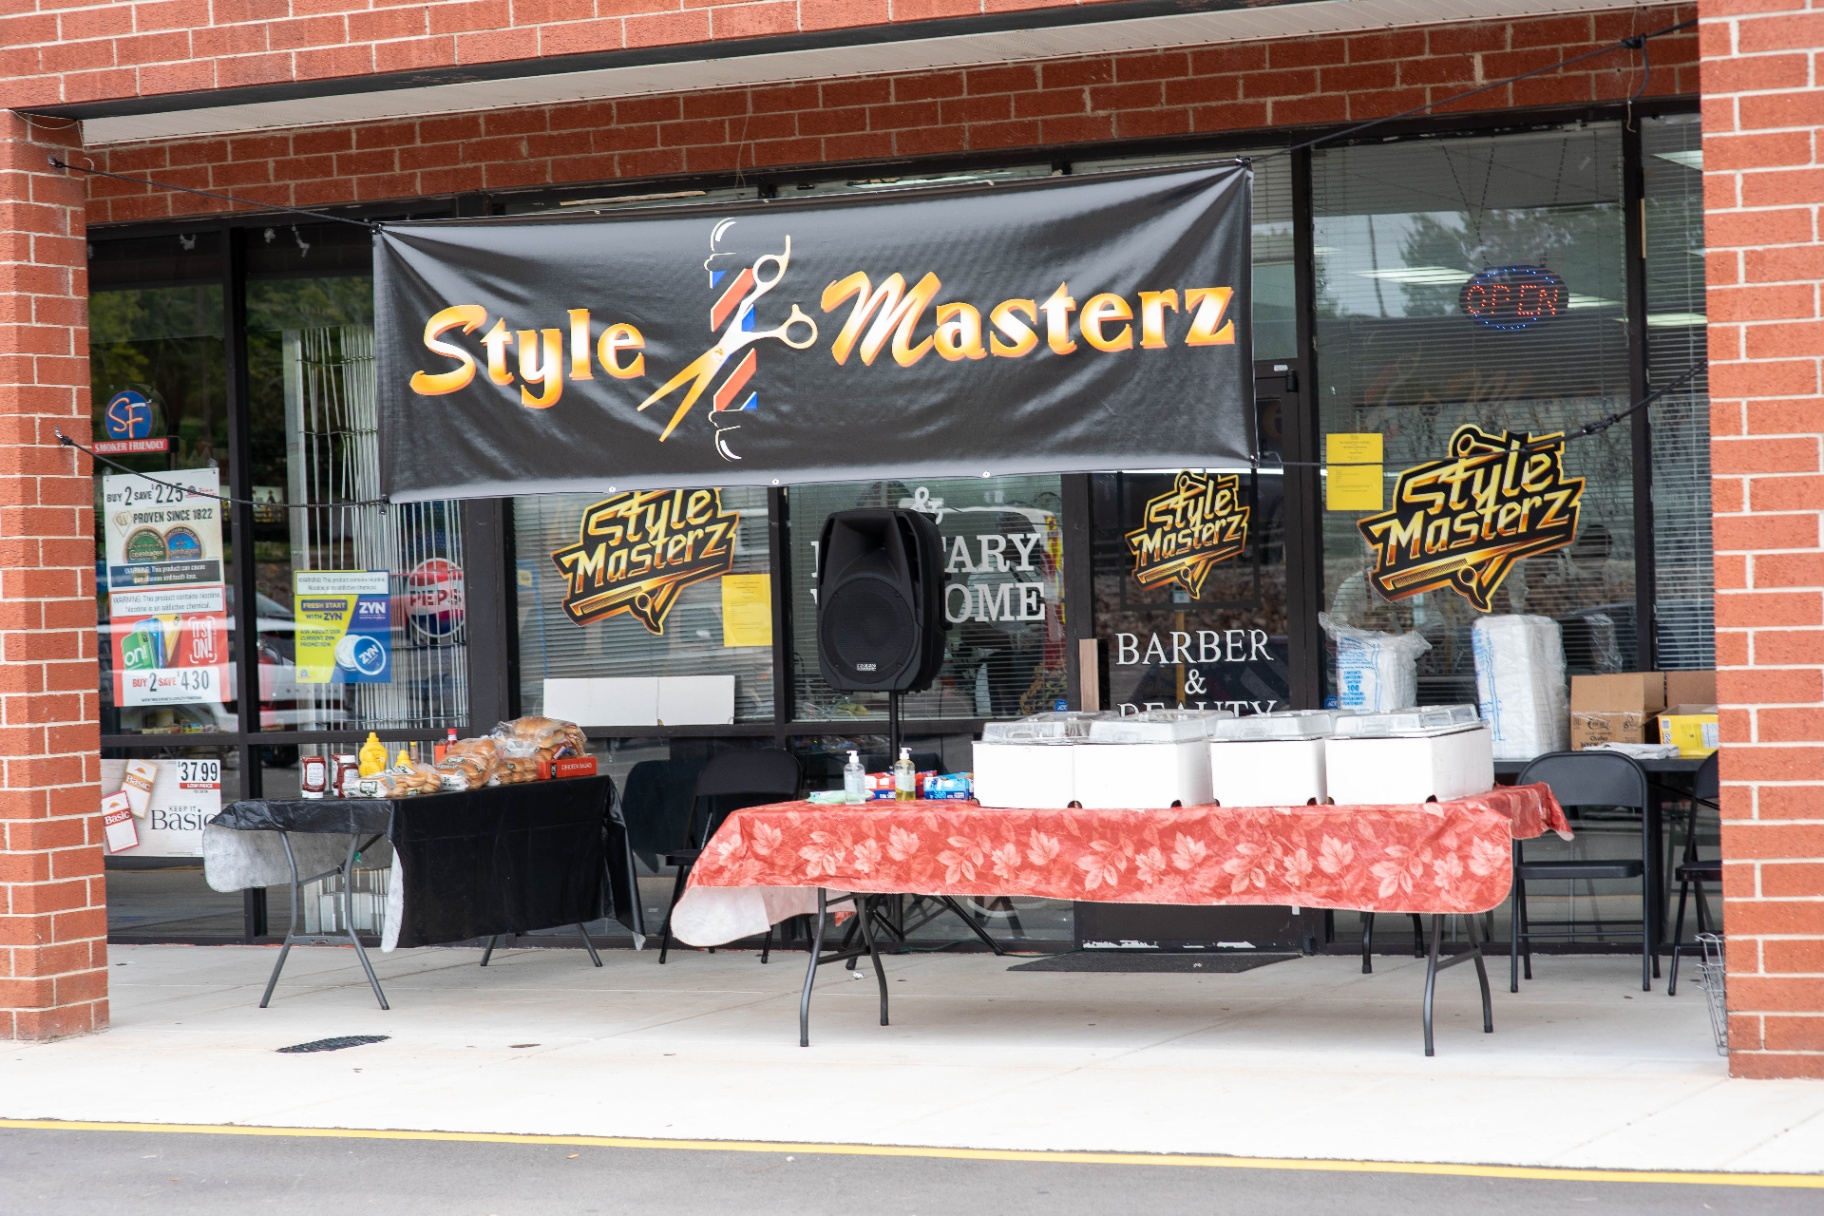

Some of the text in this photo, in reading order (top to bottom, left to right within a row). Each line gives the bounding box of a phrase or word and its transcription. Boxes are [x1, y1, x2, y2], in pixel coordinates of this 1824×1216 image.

[1467, 284, 1559, 316] OPEN
[409, 270, 1235, 409] Style Masterz
[108, 397, 146, 439] SF
[95, 440, 165, 453] SMOKER FRIENDLY
[1403, 439, 1553, 515] Style
[106, 493, 122, 502] BUY
[125, 486, 132, 506] 2
[134, 491, 152, 500] SAVE
[911, 487, 943, 525] &
[1149, 479, 1233, 532] Style
[133, 508, 212, 524] PROVEN SINCE 1822
[588, 488, 713, 546] Style
[1369, 488, 1573, 567] Masterz
[1131, 514, 1243, 567] Masterz
[560, 522, 729, 594] Masterz
[323, 612, 342, 621] ZYN
[359, 602, 386, 614] ZYN
[125, 645, 147, 666] on!
[358, 644, 380, 665] ZYN
[1115, 628, 1274, 665] BARBER
[132, 678, 147, 687] BUY
[149, 672, 157, 692] 2
[158, 677, 177, 687] SAVE
[1184, 668, 1208, 695] &
[125, 774, 151, 791] Basic
[104, 811, 131, 825] Basic
[151, 808, 217, 831] Basic
